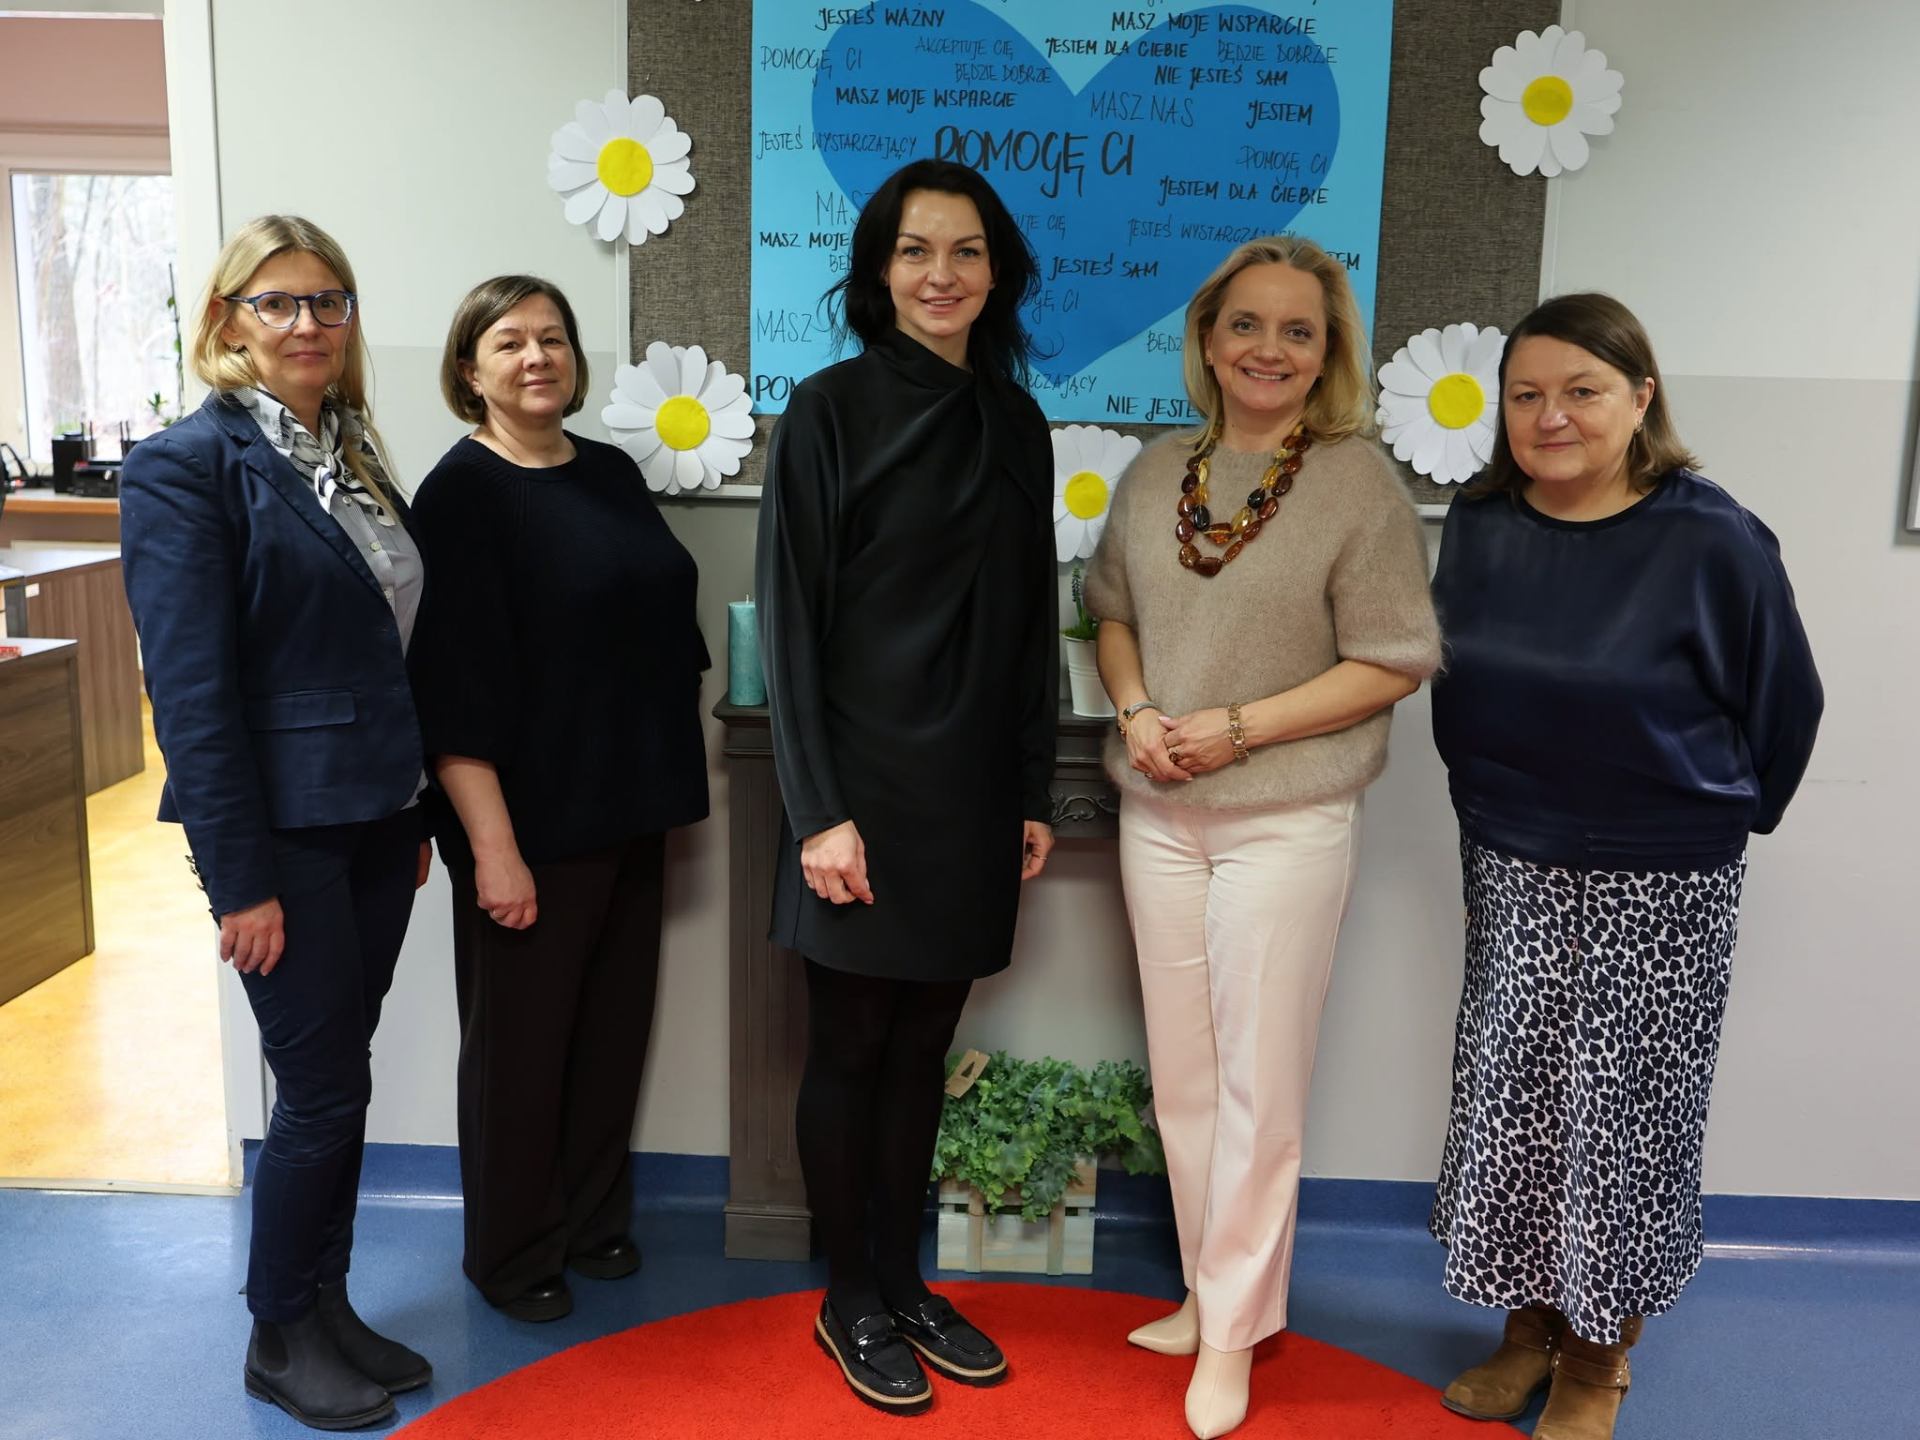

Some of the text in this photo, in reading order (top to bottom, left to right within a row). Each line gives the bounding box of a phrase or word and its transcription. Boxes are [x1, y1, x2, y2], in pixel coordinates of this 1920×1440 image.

[815, 1, 875, 31] JESTEŚ
[1111, 12, 1317, 38] MASZ MOJE WSPARCIE
[1045, 38, 1190, 58] JESTEM DLA CIEBIE
[1276, 44, 1338, 63] DOBRZE
[760, 46, 862, 87] POMOGĘ CI
[955, 62, 1051, 86] BĘDZIE DOBRZE
[1154, 64, 1288, 90] NIE JESTEŚ SAM
[835, 87, 1018, 114] MASZ MOJE WSPARCIE
[1090, 92, 1195, 128] MASZ NAS
[1246, 100, 1313, 129] JESTEM
[756, 124, 803, 160] JESTEŚ
[935, 125, 1134, 199] POMOGĘ CI
[1311, 153, 1328, 176] CI
[1159, 175, 1328, 206] JESTEM DLA CIEBIE
[816, 189, 877, 226] MAS
[760, 231, 849, 251] MASZ MOJE
[1128, 214, 1173, 246] JESTEŚ
[1047, 253, 1113, 281] JESTEŚ
[1120, 260, 1159, 277] SAM
[1063, 289, 1080, 312] CI
[757, 308, 812, 343] MASZ
[1106, 395, 1200, 422] NIE JESTE
